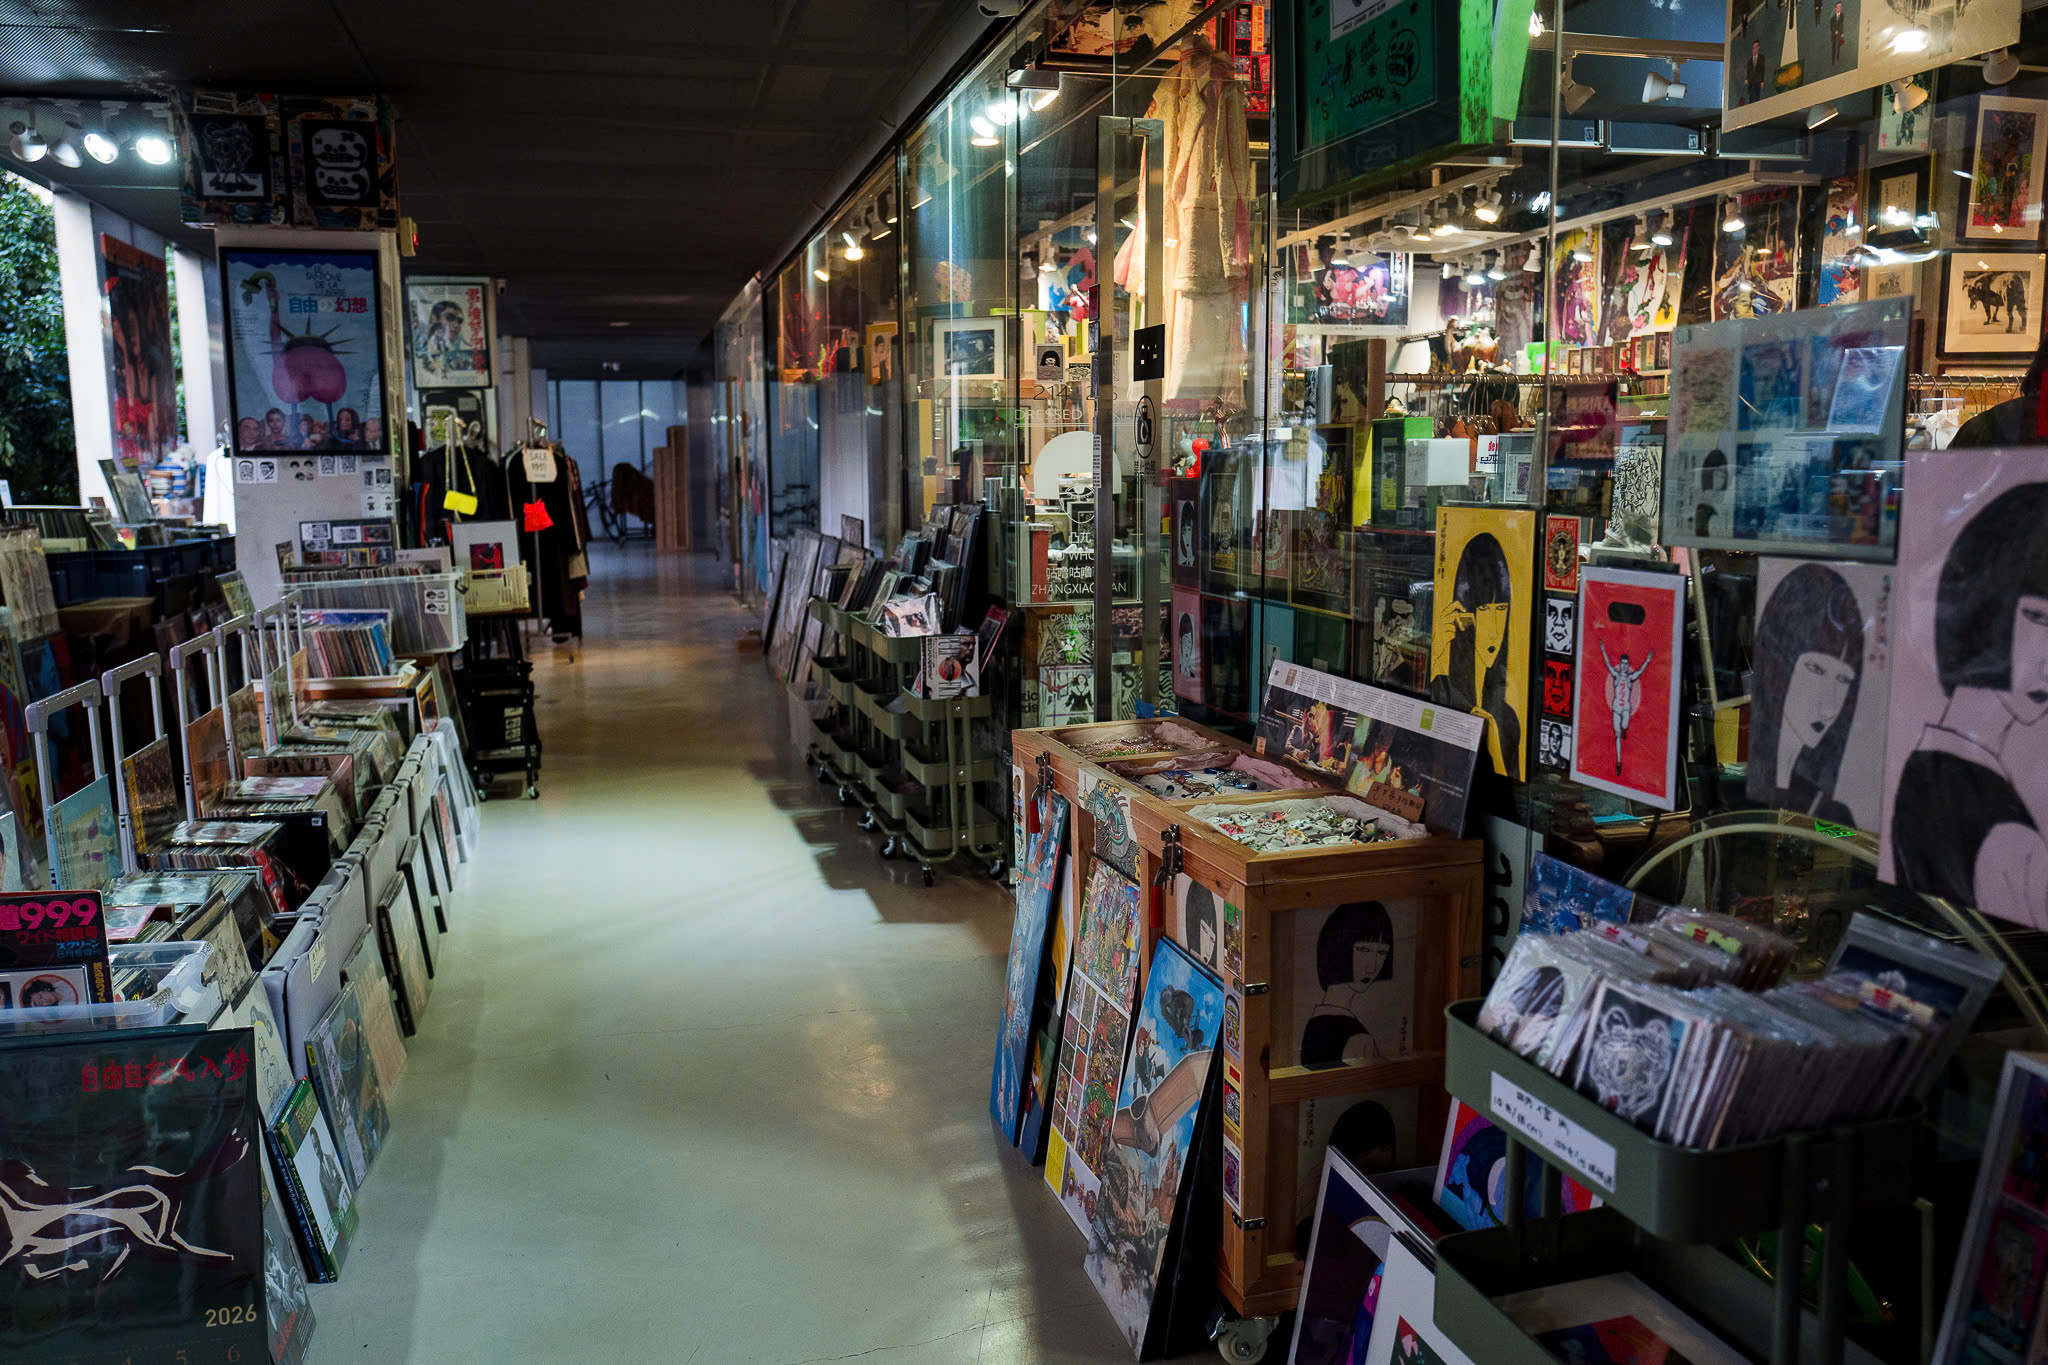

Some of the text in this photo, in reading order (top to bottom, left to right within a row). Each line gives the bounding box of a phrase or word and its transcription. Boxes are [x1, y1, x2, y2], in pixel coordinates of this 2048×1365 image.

[1034, 385, 1069, 401] 214
[1015, 408, 1083, 421] DRESSED
[1046, 565, 1095, 579] 咕噜咕噜
[266, 757, 332, 774] PANTA
[81, 1047, 251, 1093] 自由自在风入梦
[205, 1303, 257, 1328] 2026
